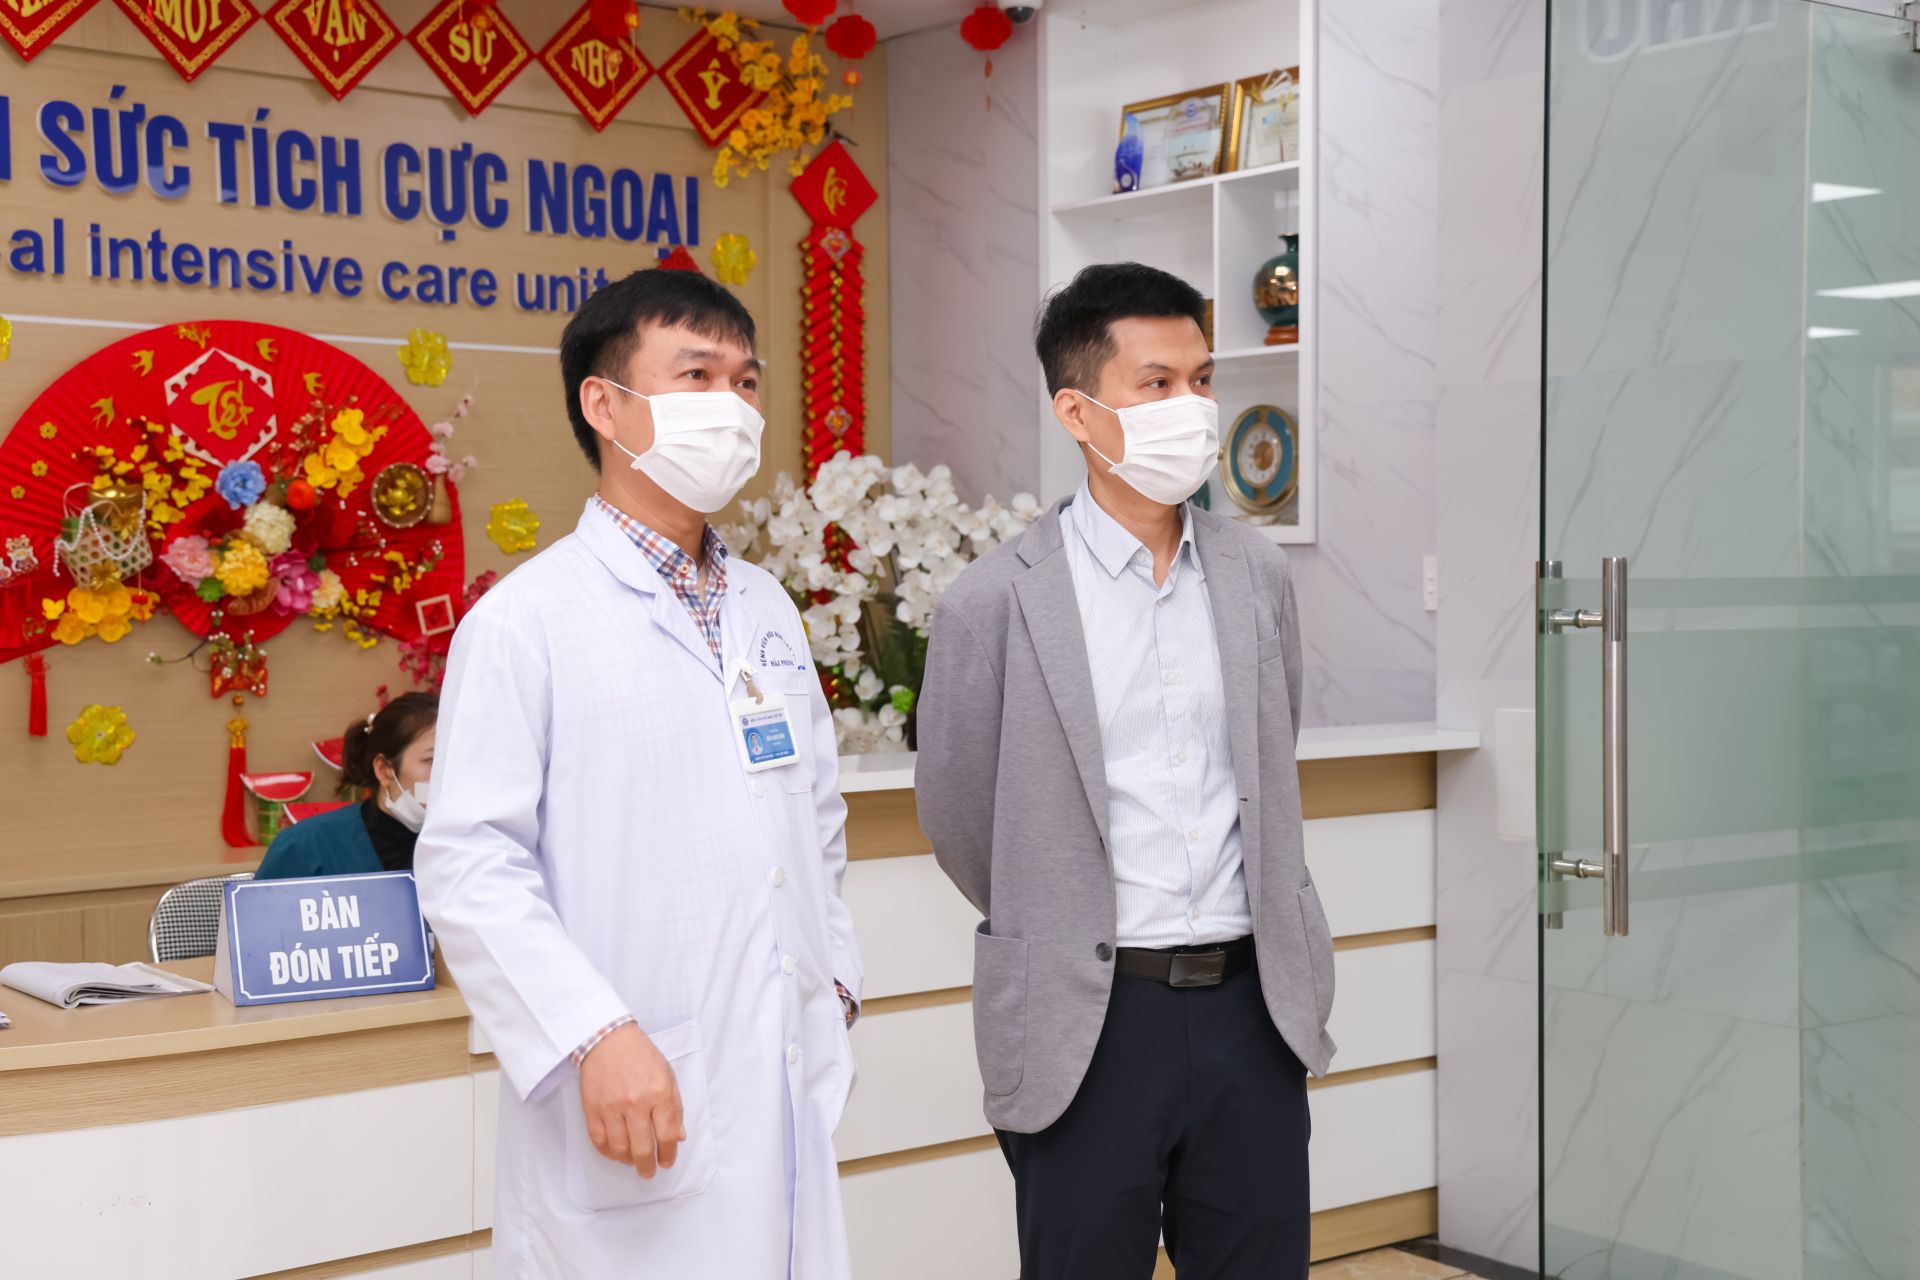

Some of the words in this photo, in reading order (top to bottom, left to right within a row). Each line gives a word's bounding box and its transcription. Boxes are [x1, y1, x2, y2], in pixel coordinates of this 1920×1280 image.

[38, 85, 190, 197] SỨC
[206, 108, 361, 216] TÍCH
[383, 143, 509, 240] CỰC
[527, 159, 699, 259] NGOẠI
[89, 223, 362, 297] intensive
[381, 262, 497, 307] care
[299, 890, 361, 932] BÀN
[270, 942, 332, 985] ĐÓN
[338, 932, 399, 979] TIẾP
